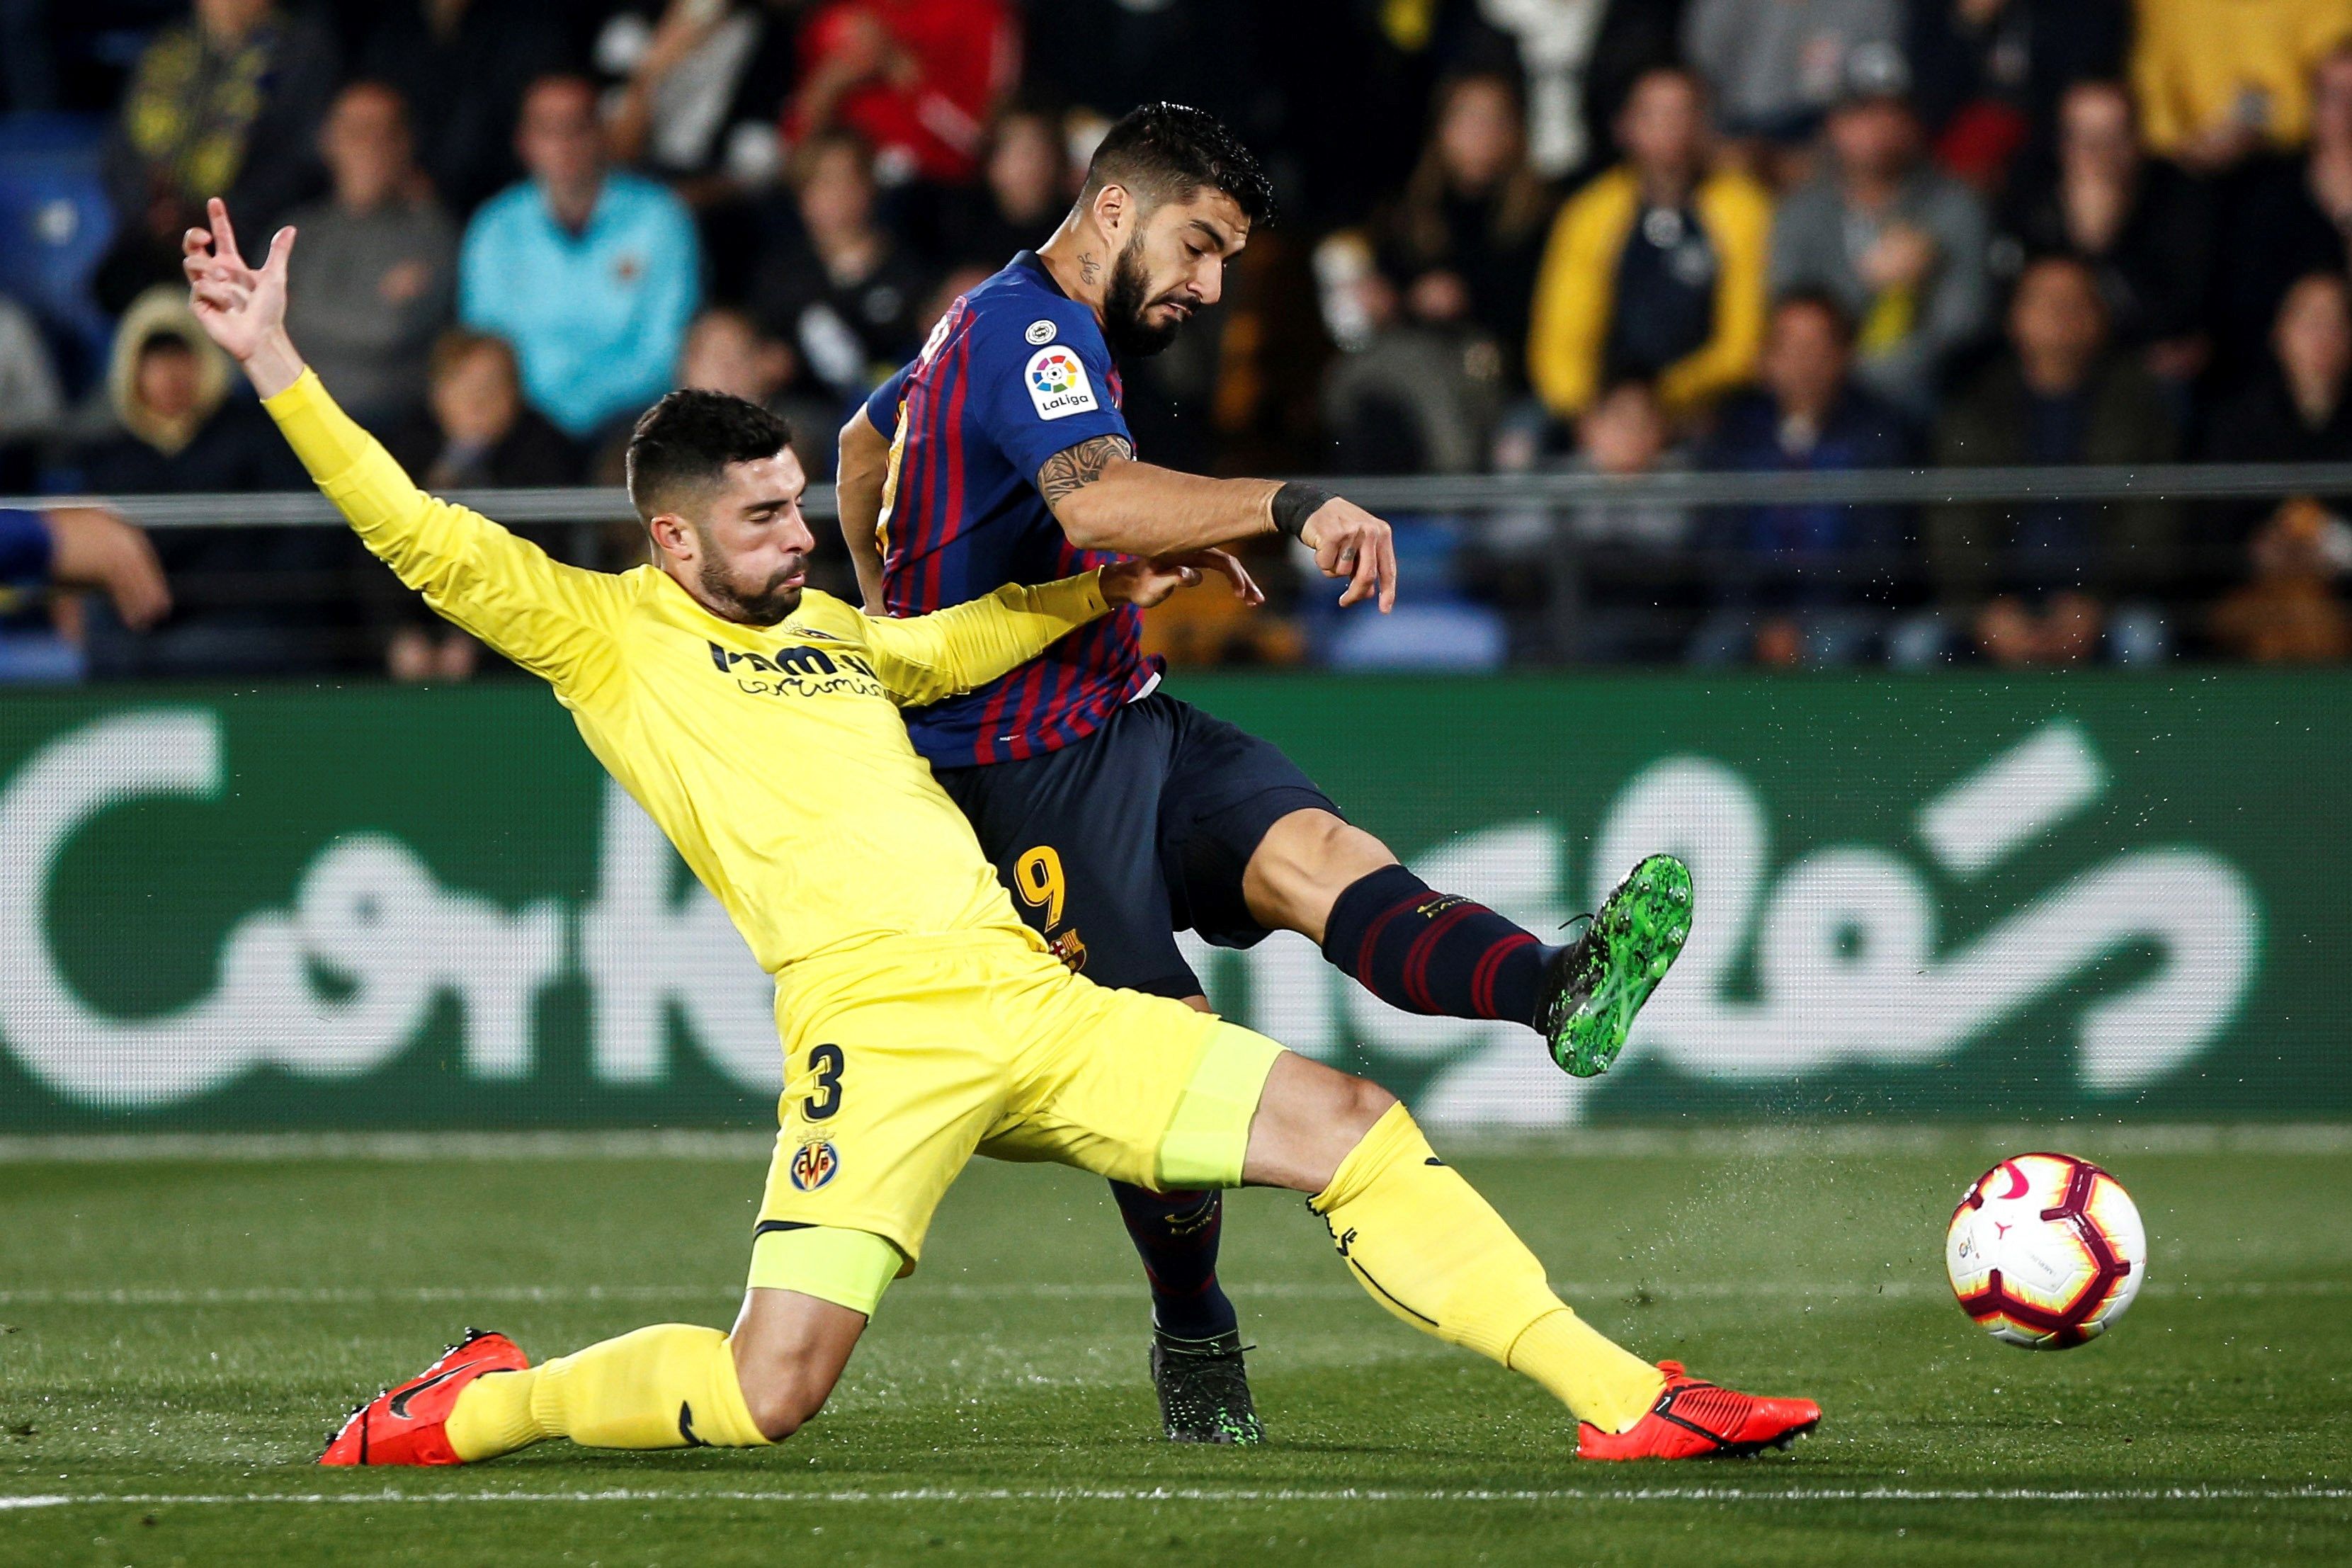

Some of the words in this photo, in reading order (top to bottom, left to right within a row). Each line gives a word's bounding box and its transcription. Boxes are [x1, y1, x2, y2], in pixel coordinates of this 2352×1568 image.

[1042, 394, 1089, 411] LaLiga
[1013, 845, 1066, 933] 9
[801, 1043, 843, 1123] 3
